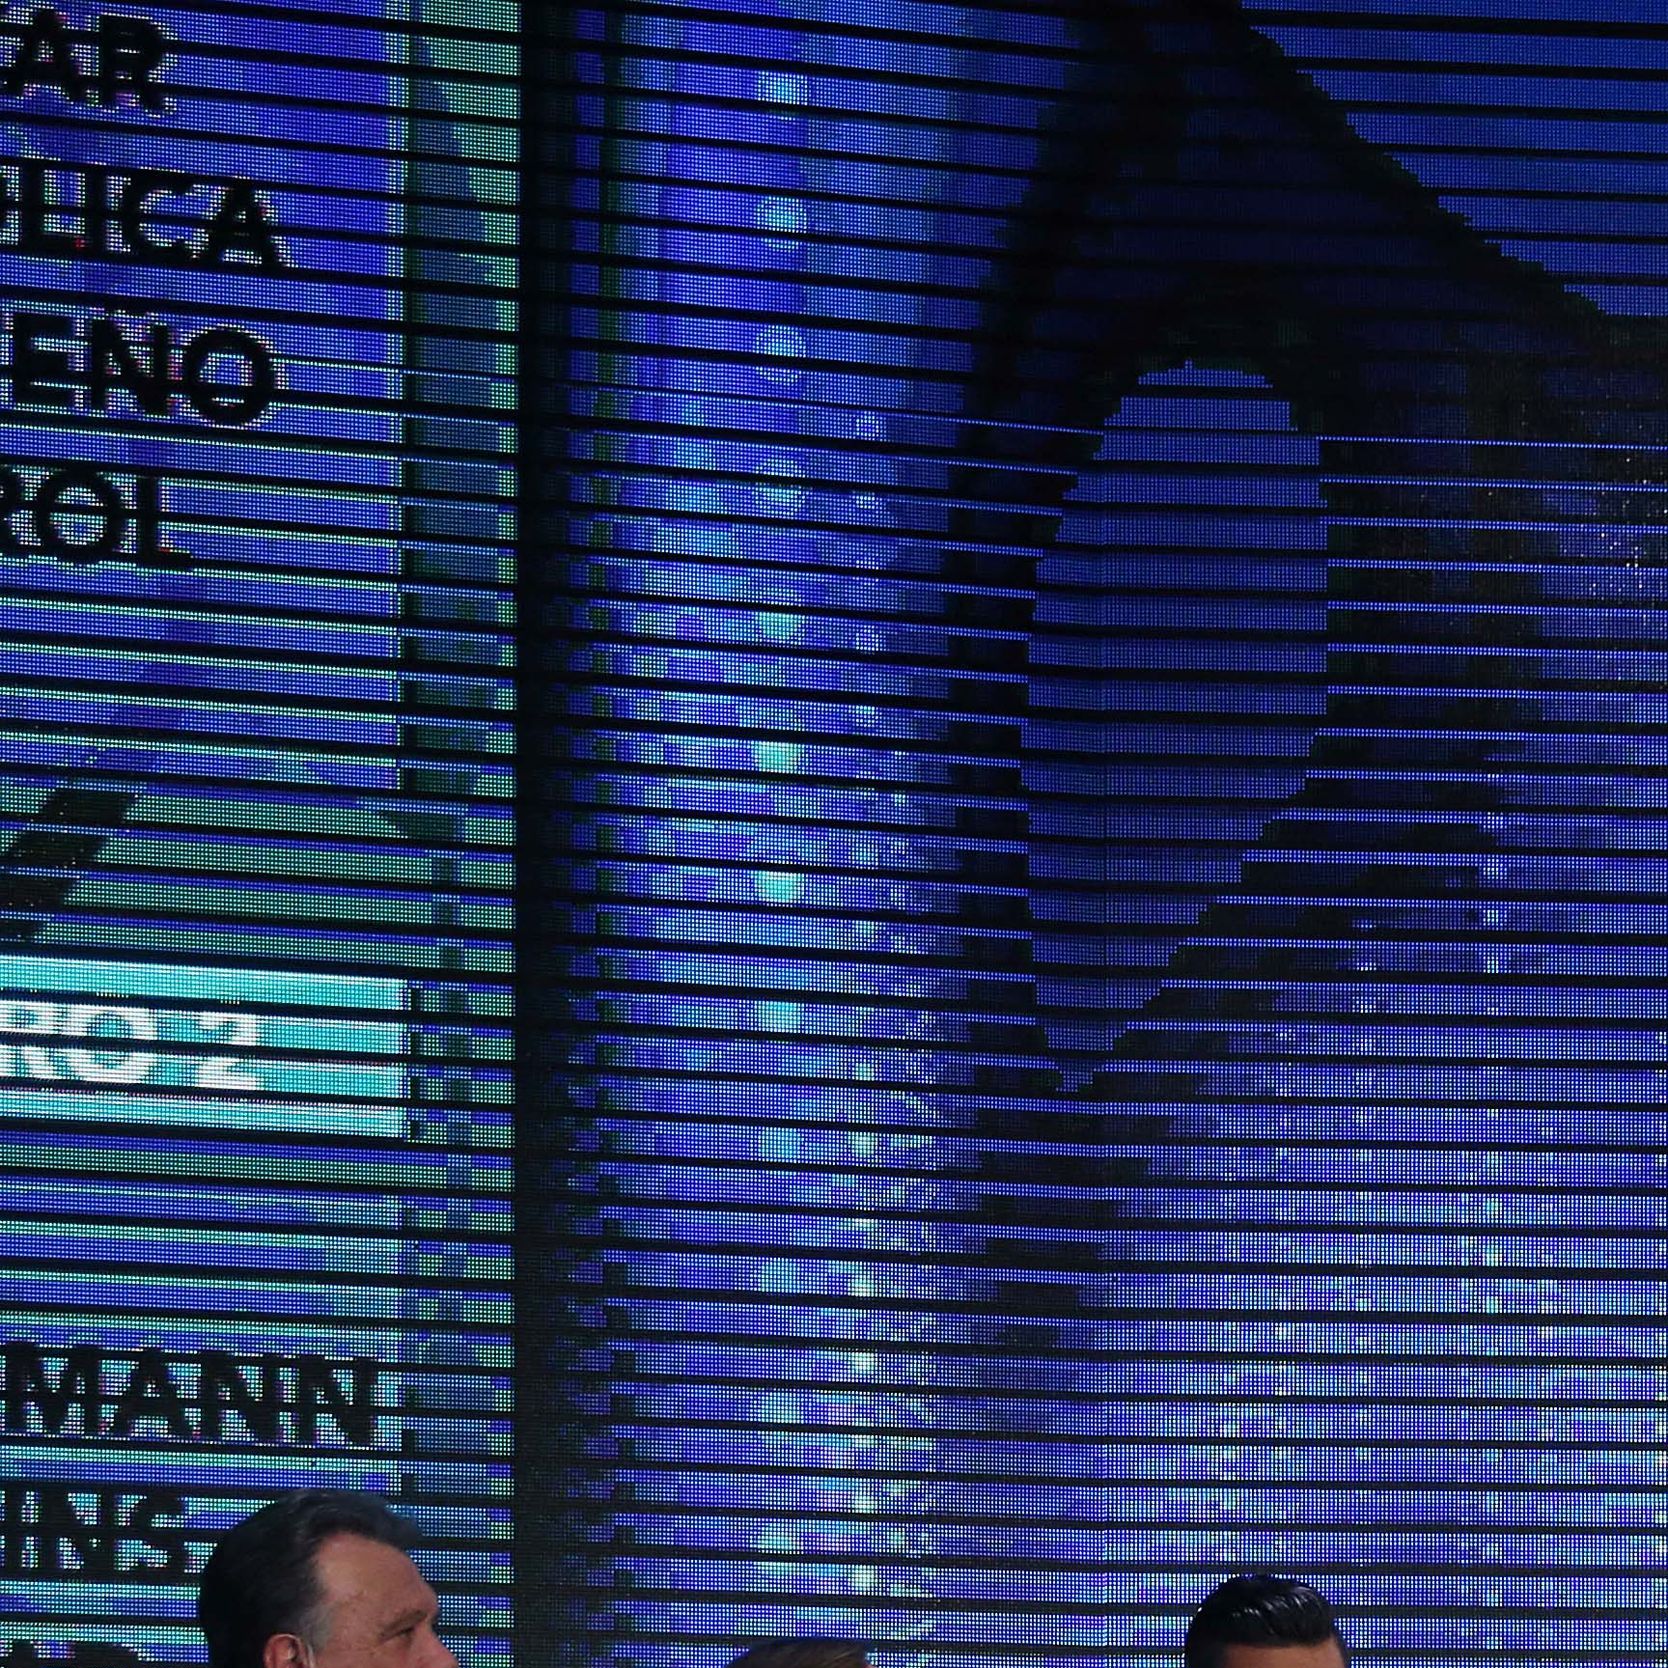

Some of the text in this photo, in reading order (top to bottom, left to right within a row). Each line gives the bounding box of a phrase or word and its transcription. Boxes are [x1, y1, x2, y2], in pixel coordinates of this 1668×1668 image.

[0, 8, 166, 114] AR
[0, 160, 285, 268] LICA
[196, 1000, 260, 1100] 2
[4, 1340, 374, 1446] MANN
